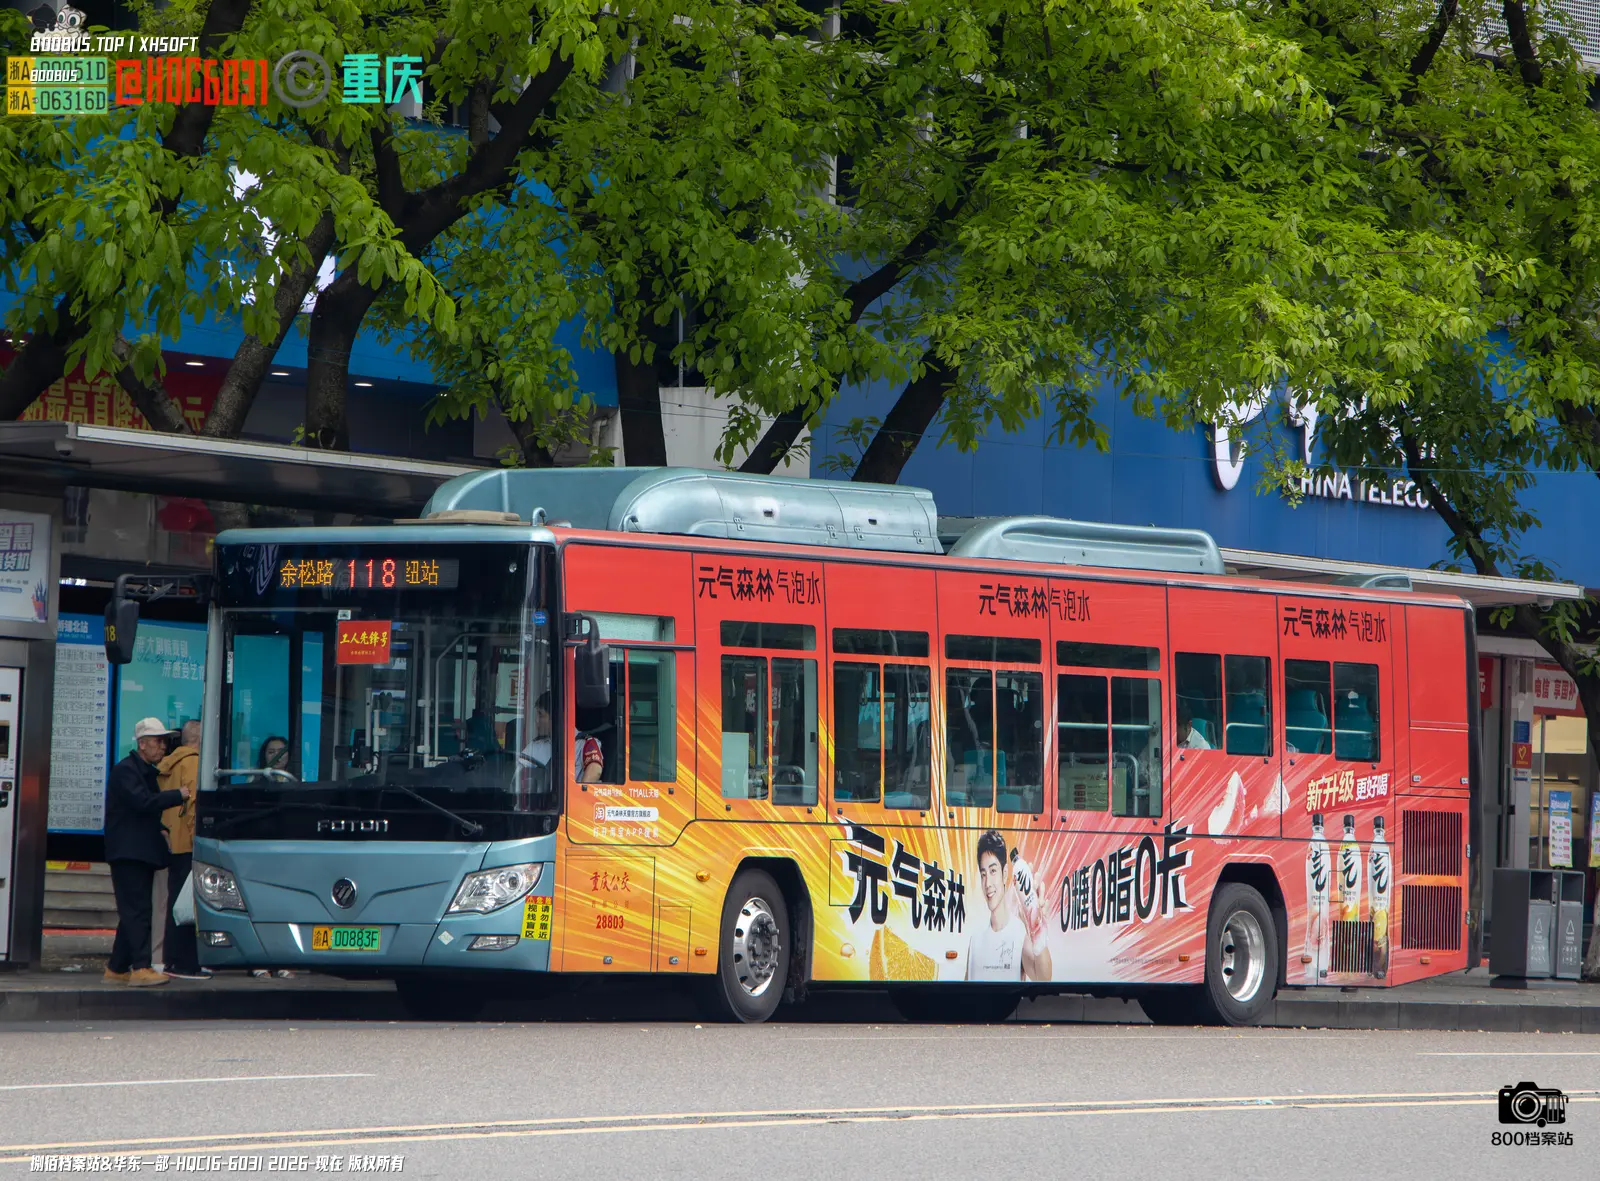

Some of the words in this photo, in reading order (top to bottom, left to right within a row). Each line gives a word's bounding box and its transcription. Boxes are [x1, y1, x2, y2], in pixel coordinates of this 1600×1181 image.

[1291, 467, 1354, 500] HINA
[280, 559, 334, 588] 余松路
[347, 558, 396, 588] 118
[405, 558, 439, 587] 纽站
[698, 565, 821, 605] 元气森林气泡水
[978, 583, 1092, 622] 元气森林气泡水
[339, 630, 388, 648] 工人先锋号
[1283, 606, 1387, 643] 元气森林气泡水
[1306, 769, 1355, 813] 新升级
[1355, 772, 1389, 802] 更好喝
[589, 871, 631, 893] 重庆公交
[840, 818, 967, 934] 元气森林
[596, 914, 624, 929] 28803
